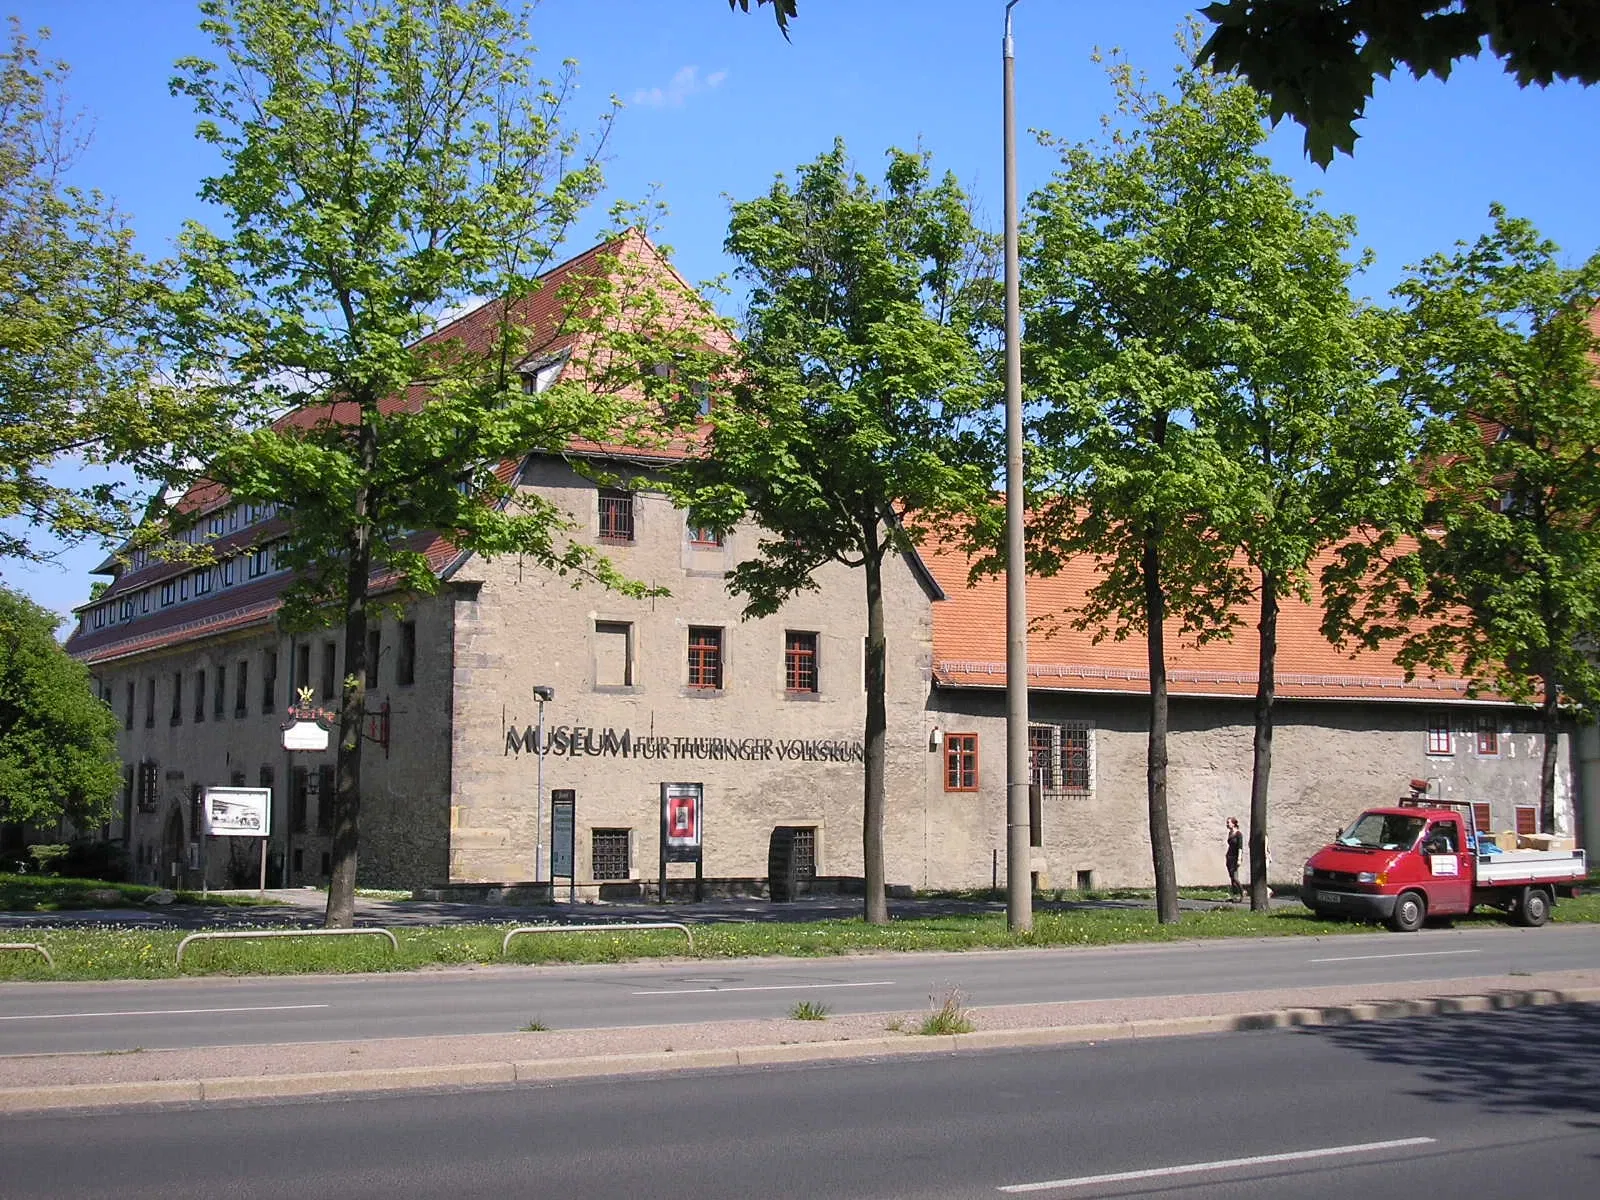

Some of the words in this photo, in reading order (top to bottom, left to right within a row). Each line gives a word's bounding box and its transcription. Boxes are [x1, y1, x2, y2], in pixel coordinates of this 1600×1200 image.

[504, 725, 631, 758] MUSEUM
[633, 736, 670, 759] FÜR
[670, 737, 774, 760] THÜRINGER
[776, 739, 866, 763] VOLKSKUN
